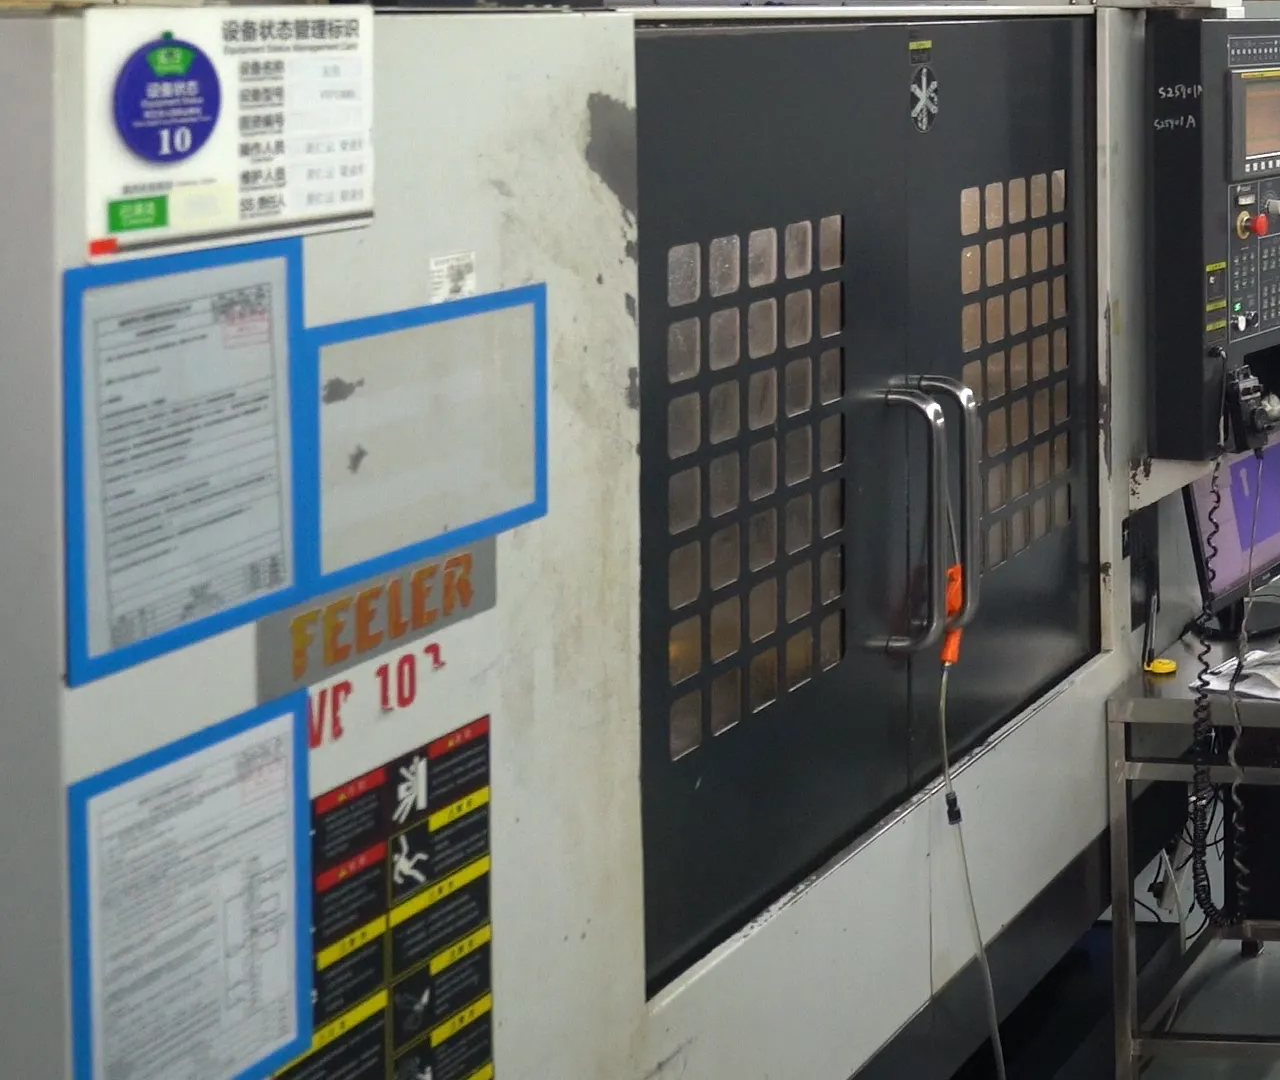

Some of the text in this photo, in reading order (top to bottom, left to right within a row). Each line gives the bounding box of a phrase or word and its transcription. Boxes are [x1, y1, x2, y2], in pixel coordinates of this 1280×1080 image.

[222, 18, 360, 42] 设备状态管理标识
[158, 126, 193, 156] 10
[288, 552, 474, 682] FEELER
